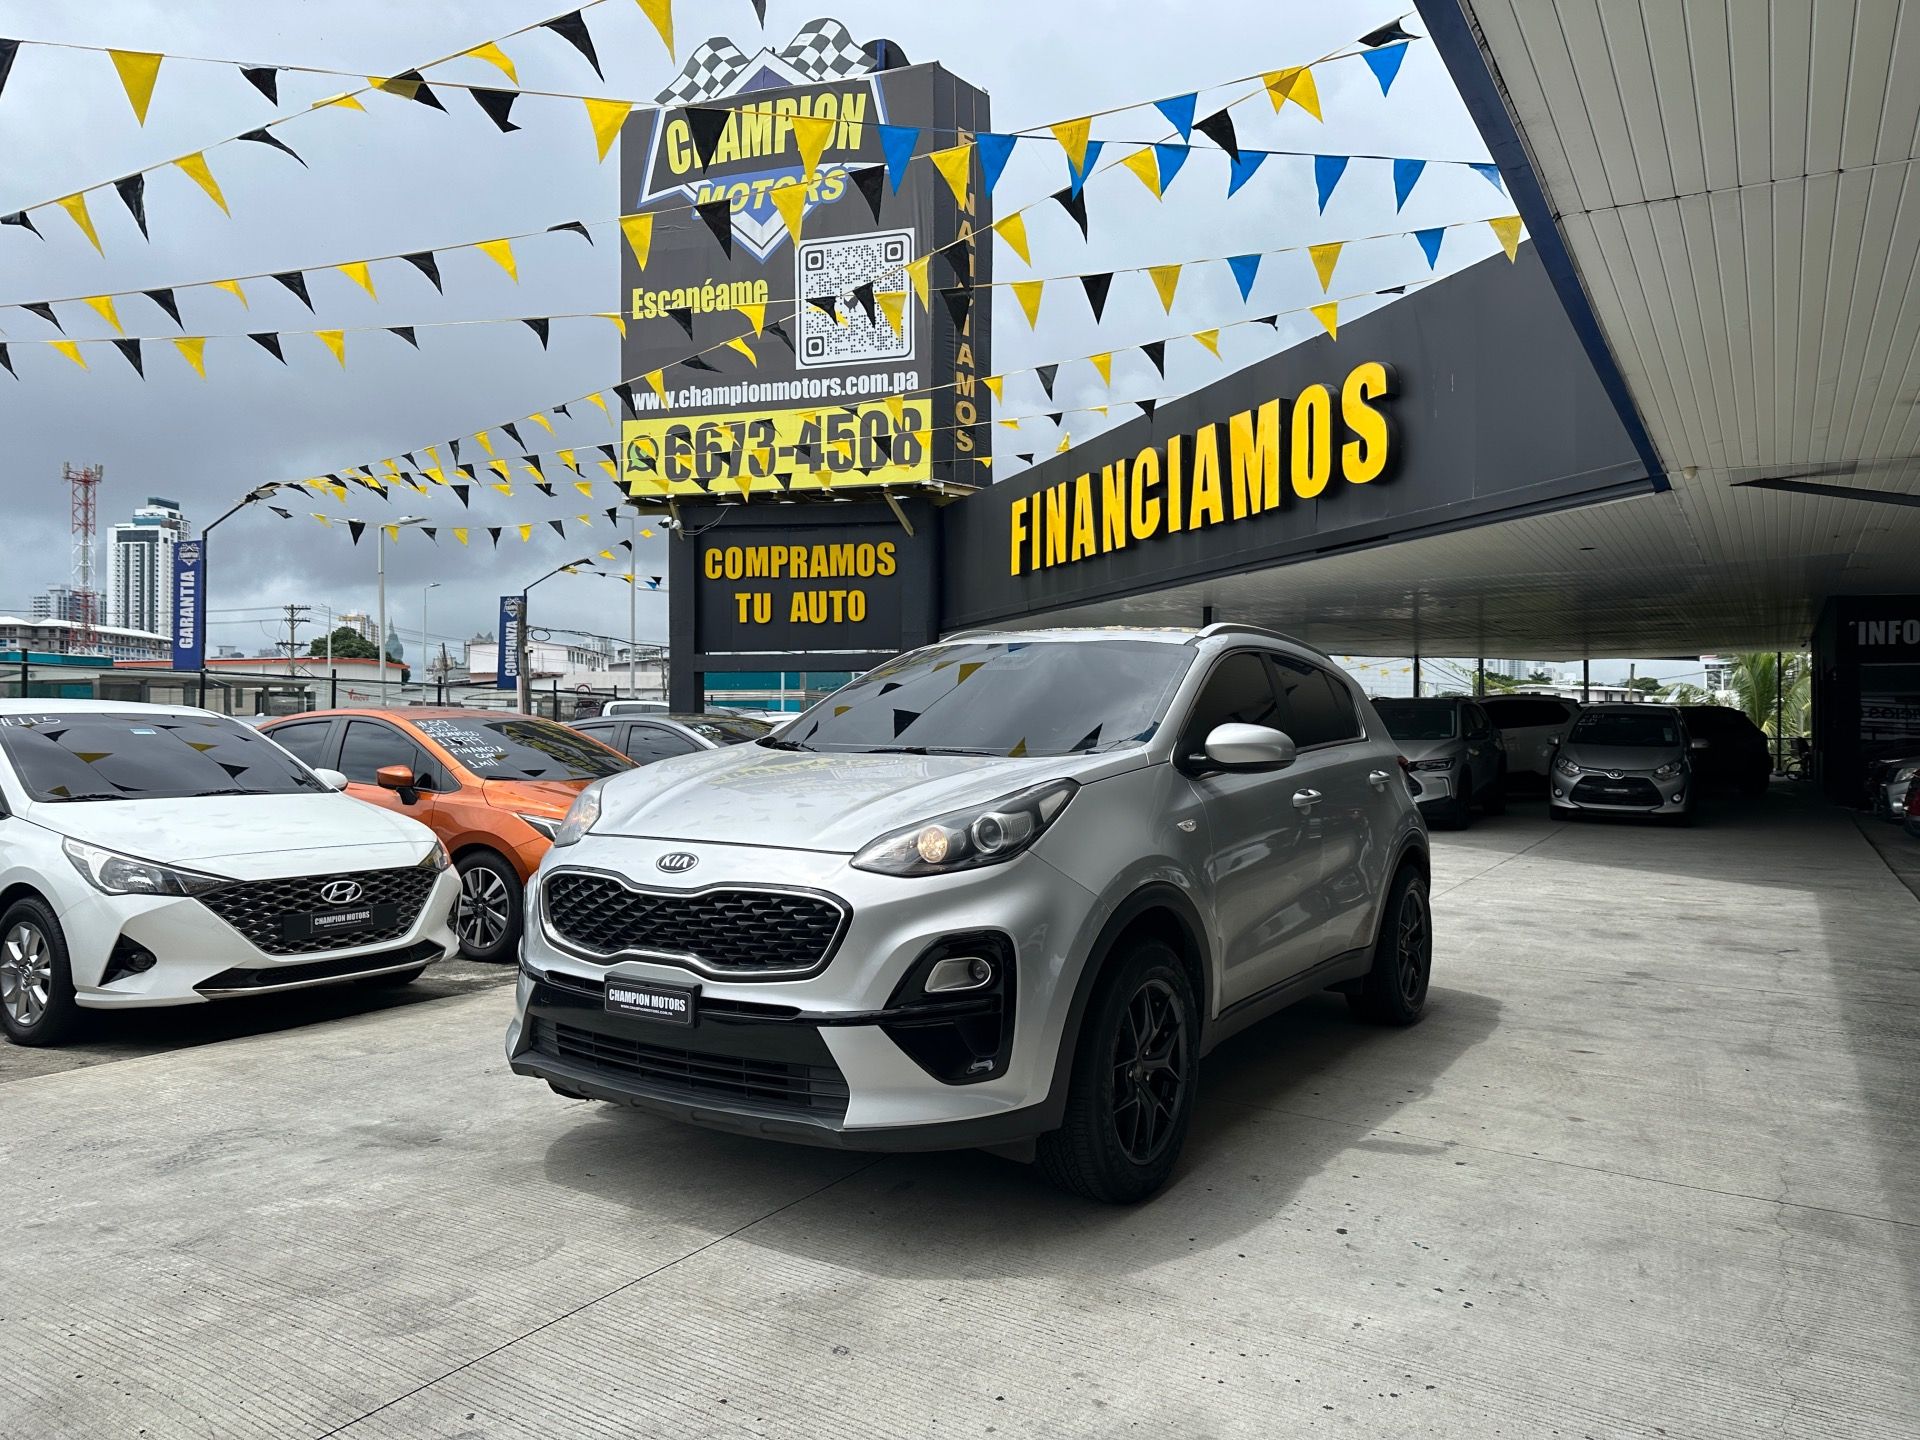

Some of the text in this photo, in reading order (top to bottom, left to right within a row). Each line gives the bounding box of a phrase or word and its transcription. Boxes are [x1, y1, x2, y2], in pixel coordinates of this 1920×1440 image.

[632, 278, 769, 319] Escanéame
[631, 371, 919, 411] www.championmotors.com.pa
[664, 408, 922, 482] 6673-4508
[1010, 361, 1392, 577] FINANCIAMOS
[704, 541, 896, 580] COMPRAMOS
[179, 570, 195, 649] GARANTIA
[735, 589, 866, 624] TU AUTO
[505, 620, 518, 677] CONFIANZA
[1858, 619, 1920, 645] INFO
[661, 855, 690, 868] KIA
[314, 914, 346, 925] CHAMPION
[346, 911, 370, 921] MOTORS
[609, 988, 686, 1012] CHAMPION MOTORS
